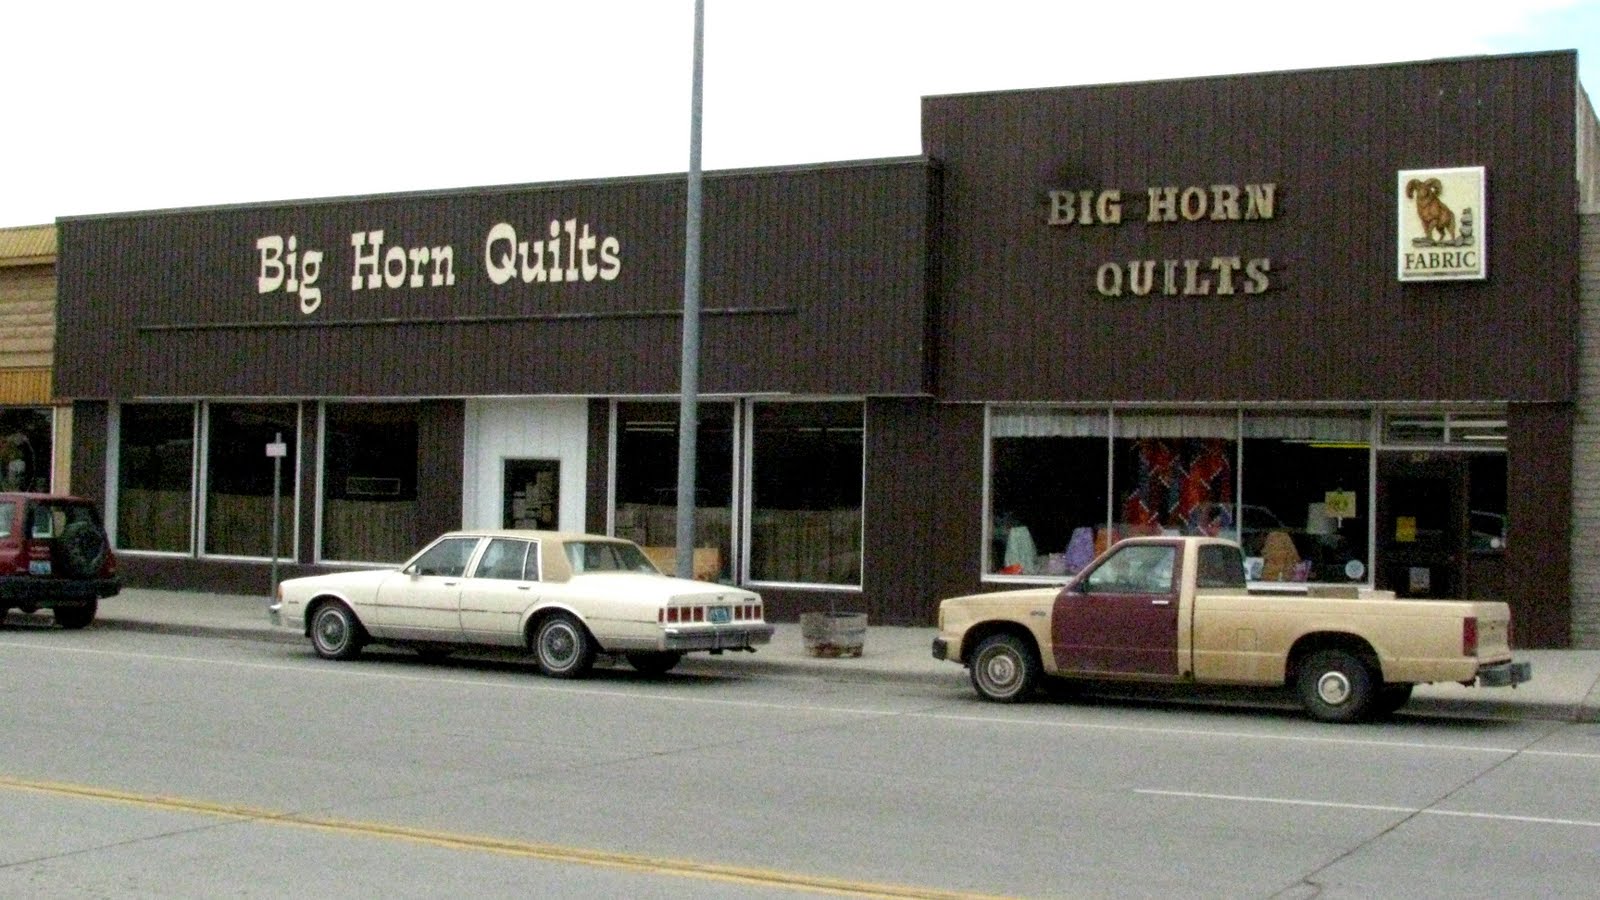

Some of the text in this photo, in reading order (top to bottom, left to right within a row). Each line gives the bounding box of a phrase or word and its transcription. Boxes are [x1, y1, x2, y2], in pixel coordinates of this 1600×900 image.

[1048, 183, 1277, 225] BIG HORN
[256, 218, 621, 314] Big Horn Quilts
[1096, 256, 1271, 297] QUILTS
[1405, 251, 1476, 269] FABRIC
